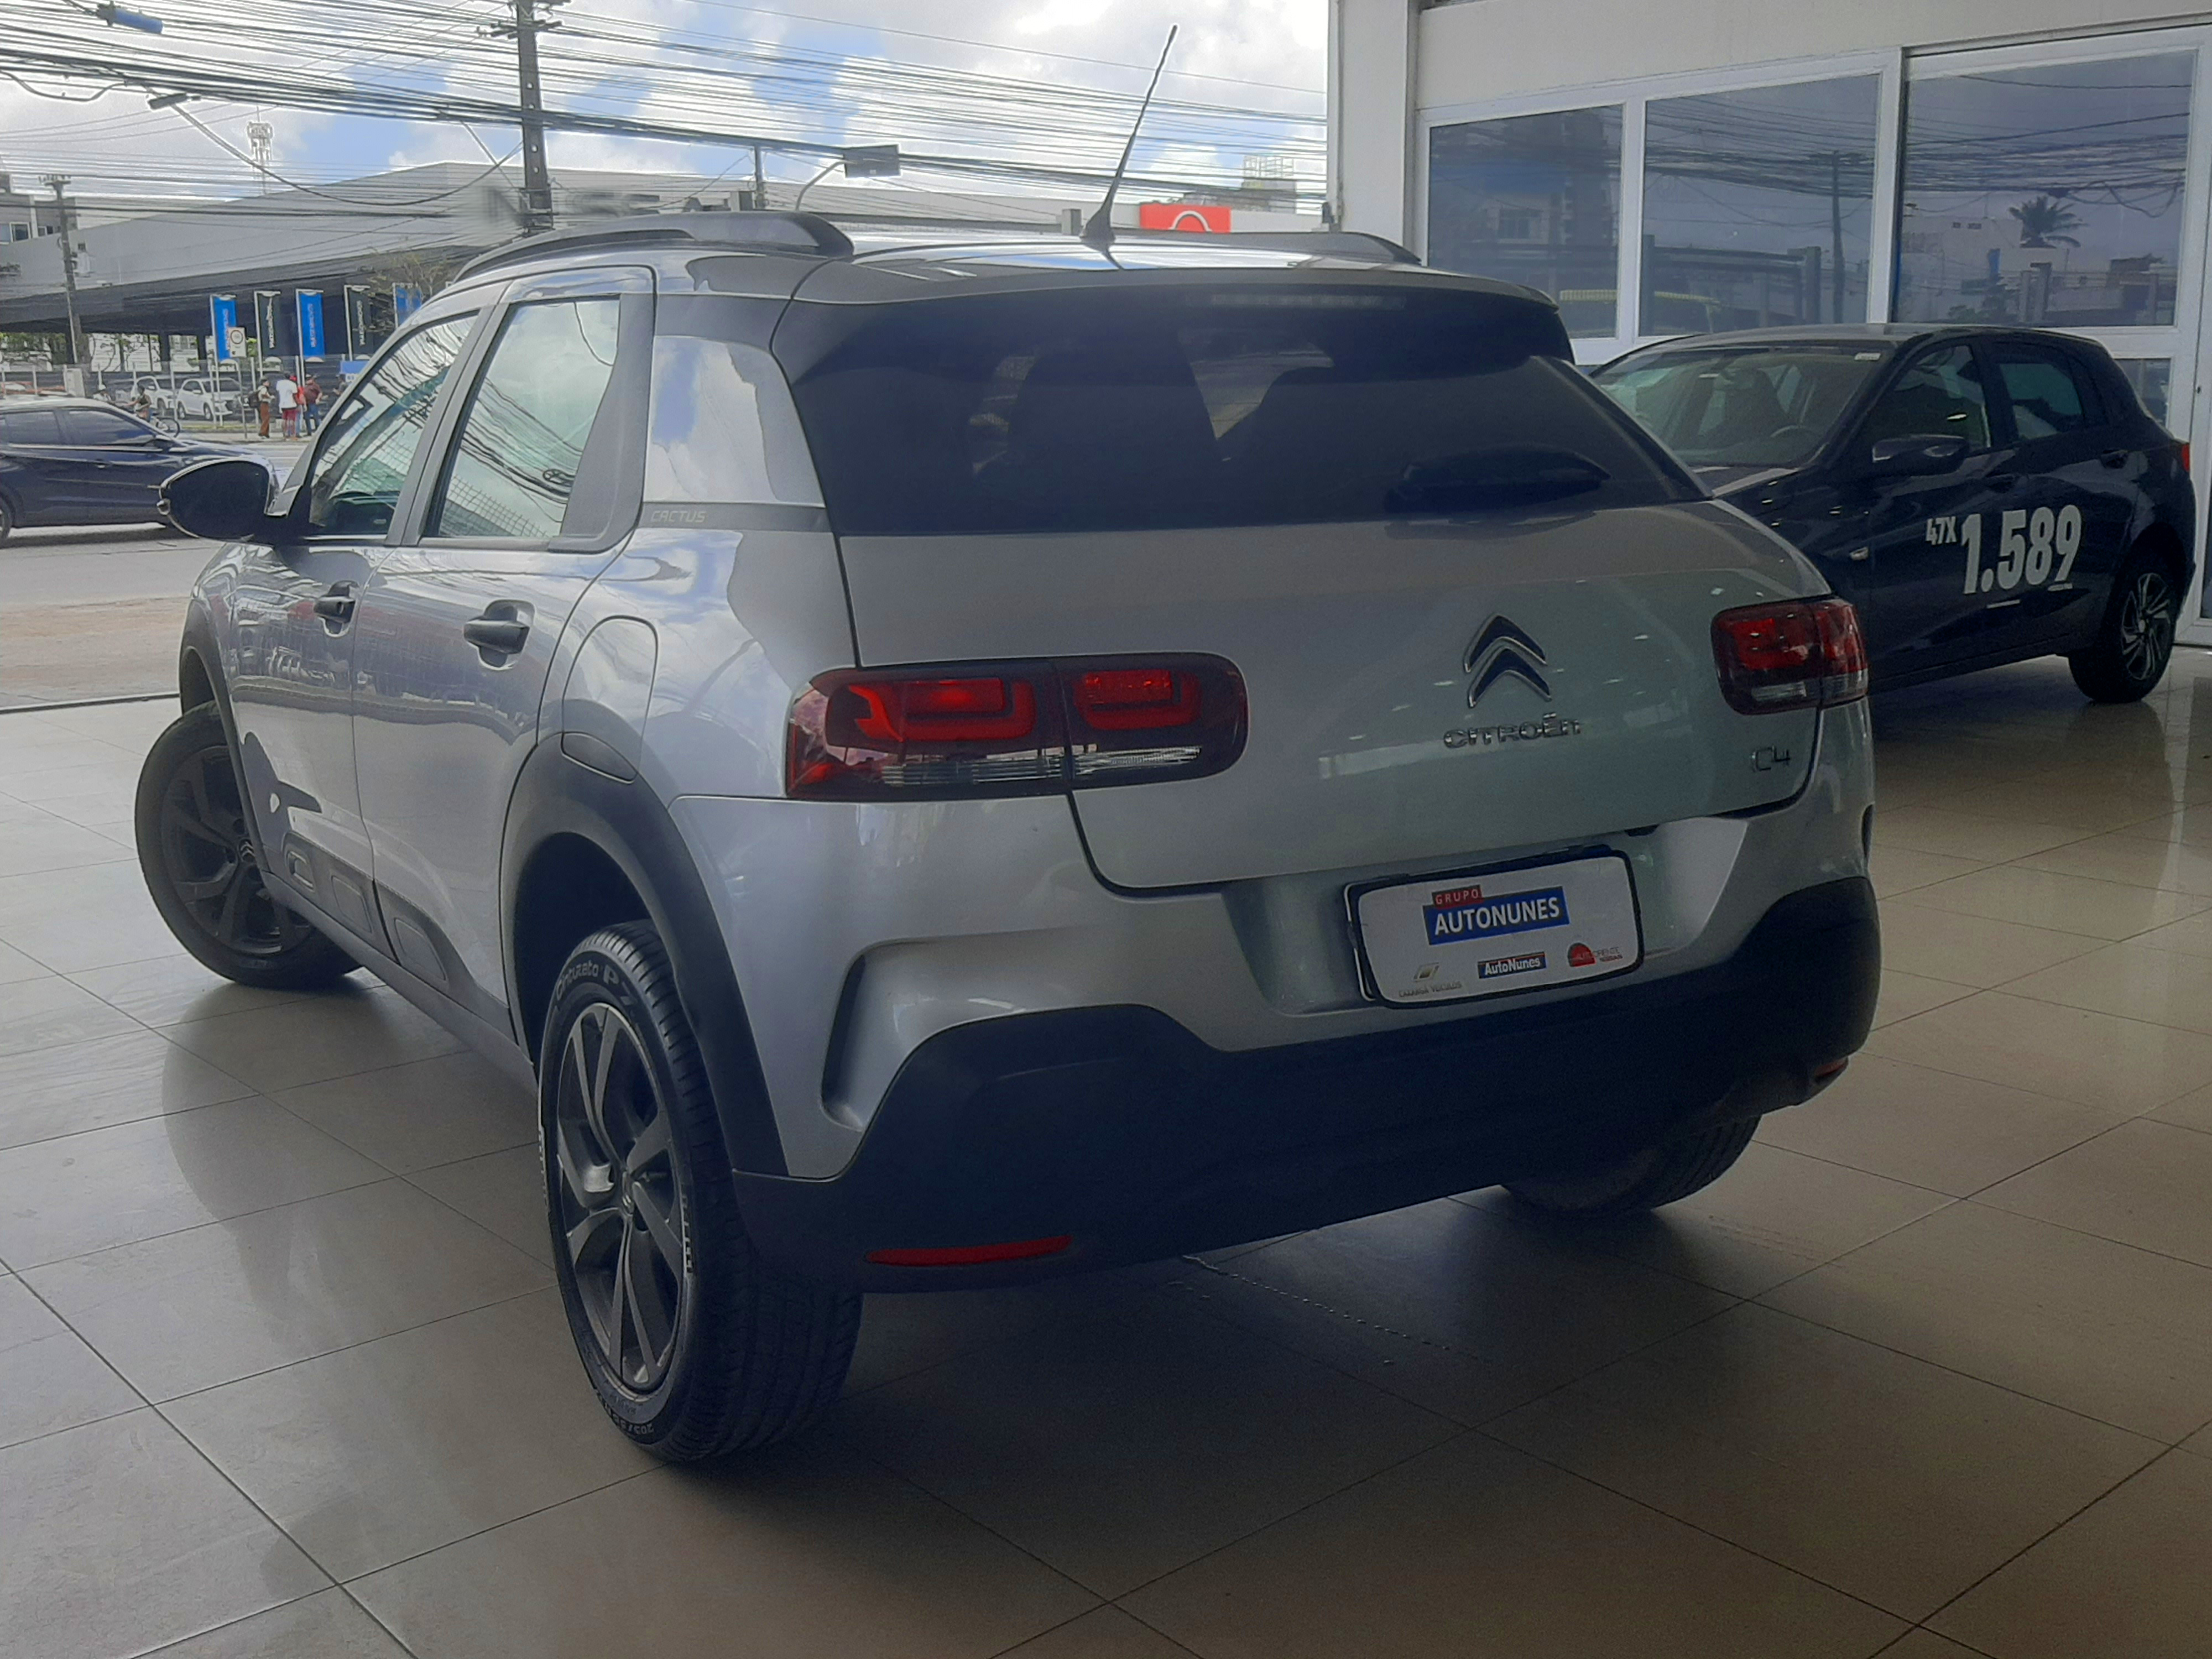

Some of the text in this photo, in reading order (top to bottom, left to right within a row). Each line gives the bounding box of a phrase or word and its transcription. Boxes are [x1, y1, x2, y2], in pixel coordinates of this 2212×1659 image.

[650, 510, 707, 523] CACTUS
[1926, 504, 2081, 594] 47X 1.589
[1751, 745, 1791, 773] C4
[1435, 889, 1480, 905] GRUPO
[1434, 896, 1561, 936] AUTONUNES
[556, 959, 599, 1001] Cinturato
[1484, 957, 1541, 976] AutoNunes
